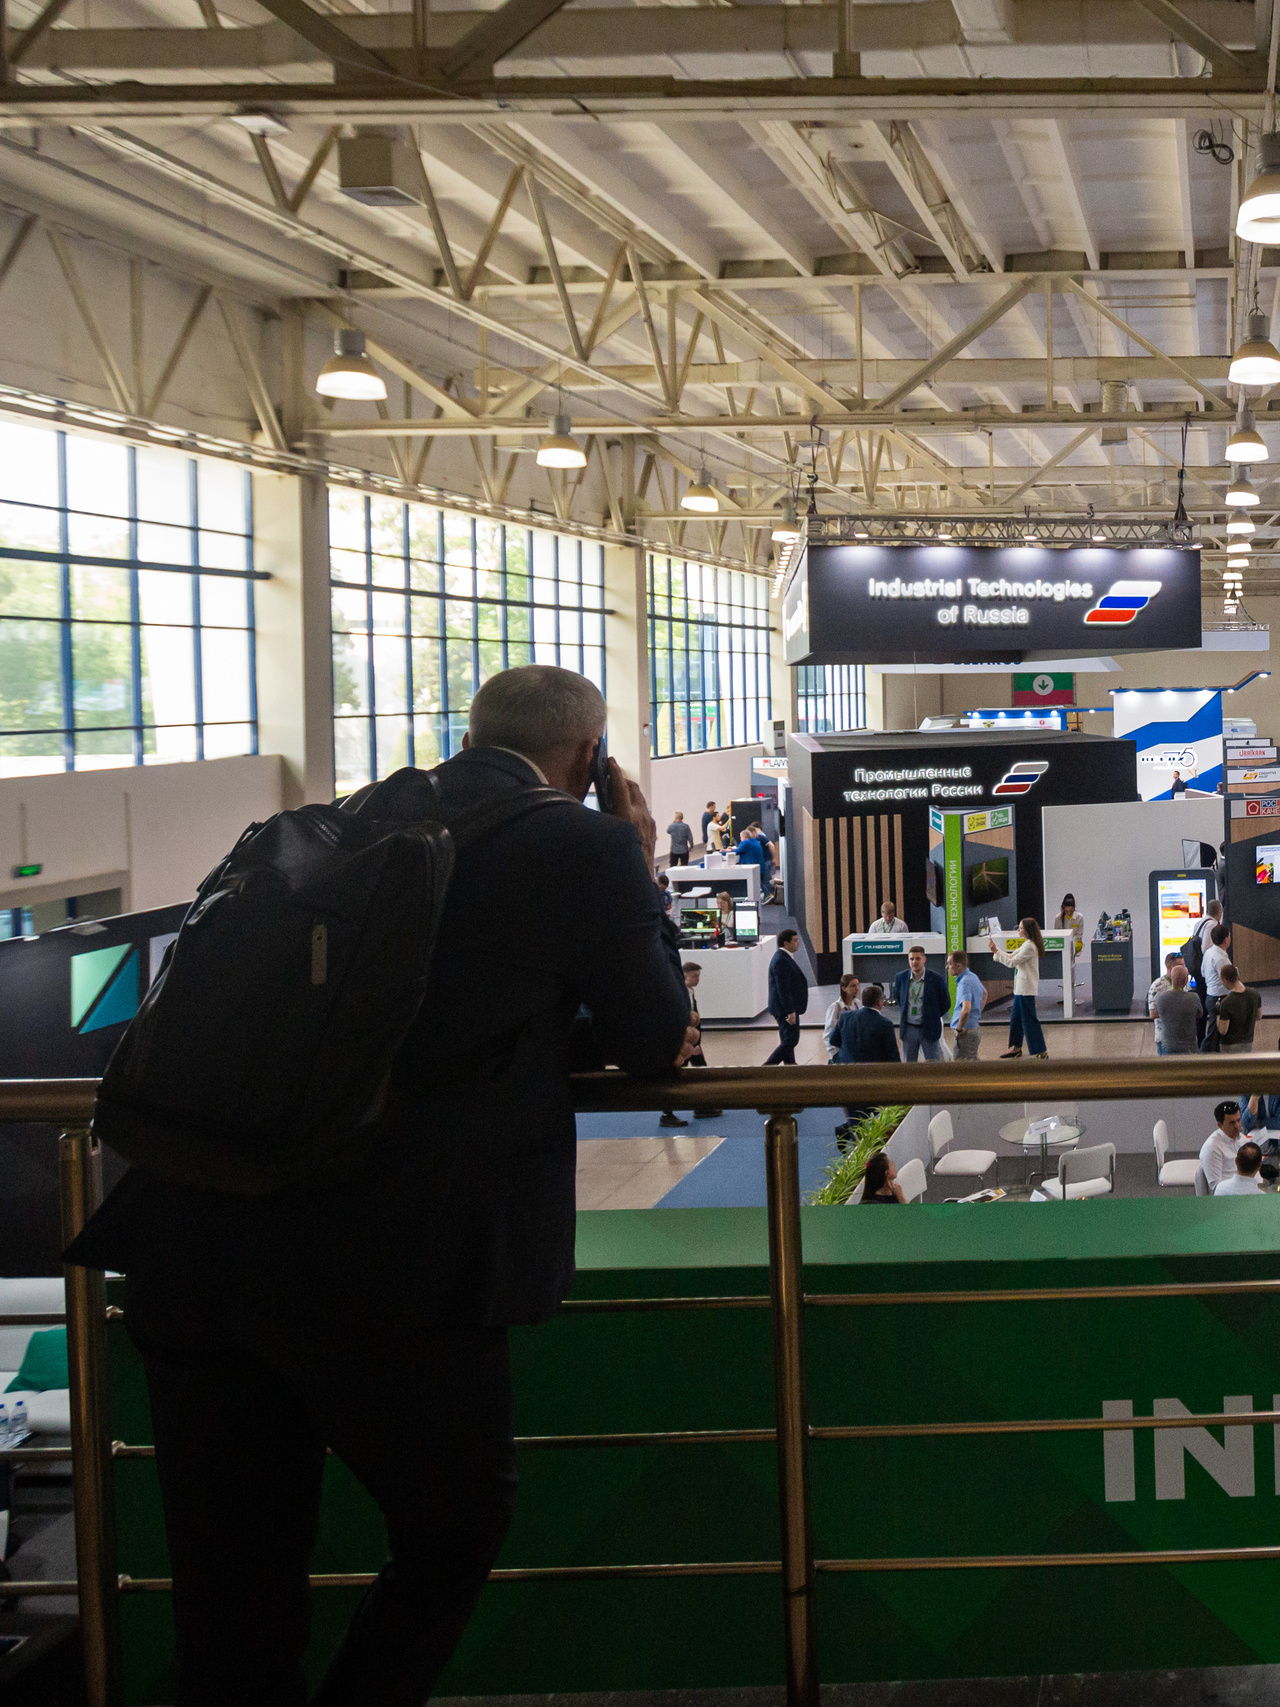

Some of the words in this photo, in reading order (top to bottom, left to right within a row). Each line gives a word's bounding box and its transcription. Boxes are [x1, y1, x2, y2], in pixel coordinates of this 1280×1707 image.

[869, 578, 962, 598] Industrial
[968, 578, 1093, 600] Technologies
[937, 605, 959, 623] of
[964, 605, 1029, 624] Russia
[855, 766, 972, 783] Промышленные
[843, 788, 928, 802] технологии
[932, 784, 983, 798] России
[949, 860, 958, 922] ТЕХНОЛОГИИ
[950, 924, 959, 951] ОВЫЕ
